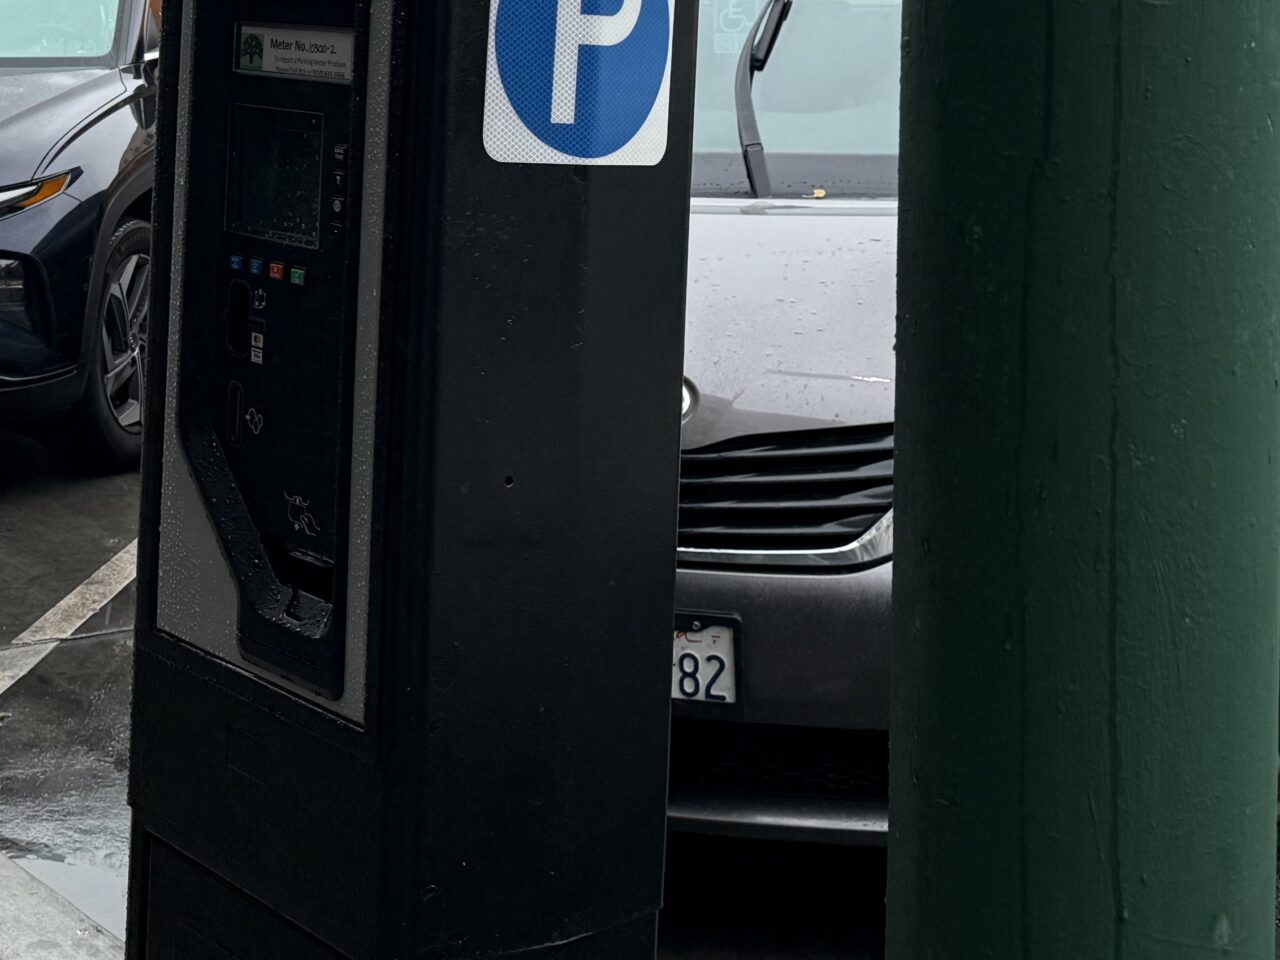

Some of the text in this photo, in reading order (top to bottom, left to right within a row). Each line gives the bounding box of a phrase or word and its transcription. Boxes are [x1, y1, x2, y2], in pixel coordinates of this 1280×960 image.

[270, 38, 292, 51] Meter
[294, 40, 307, 52] No.
[673, 652, 727, 701] 82
